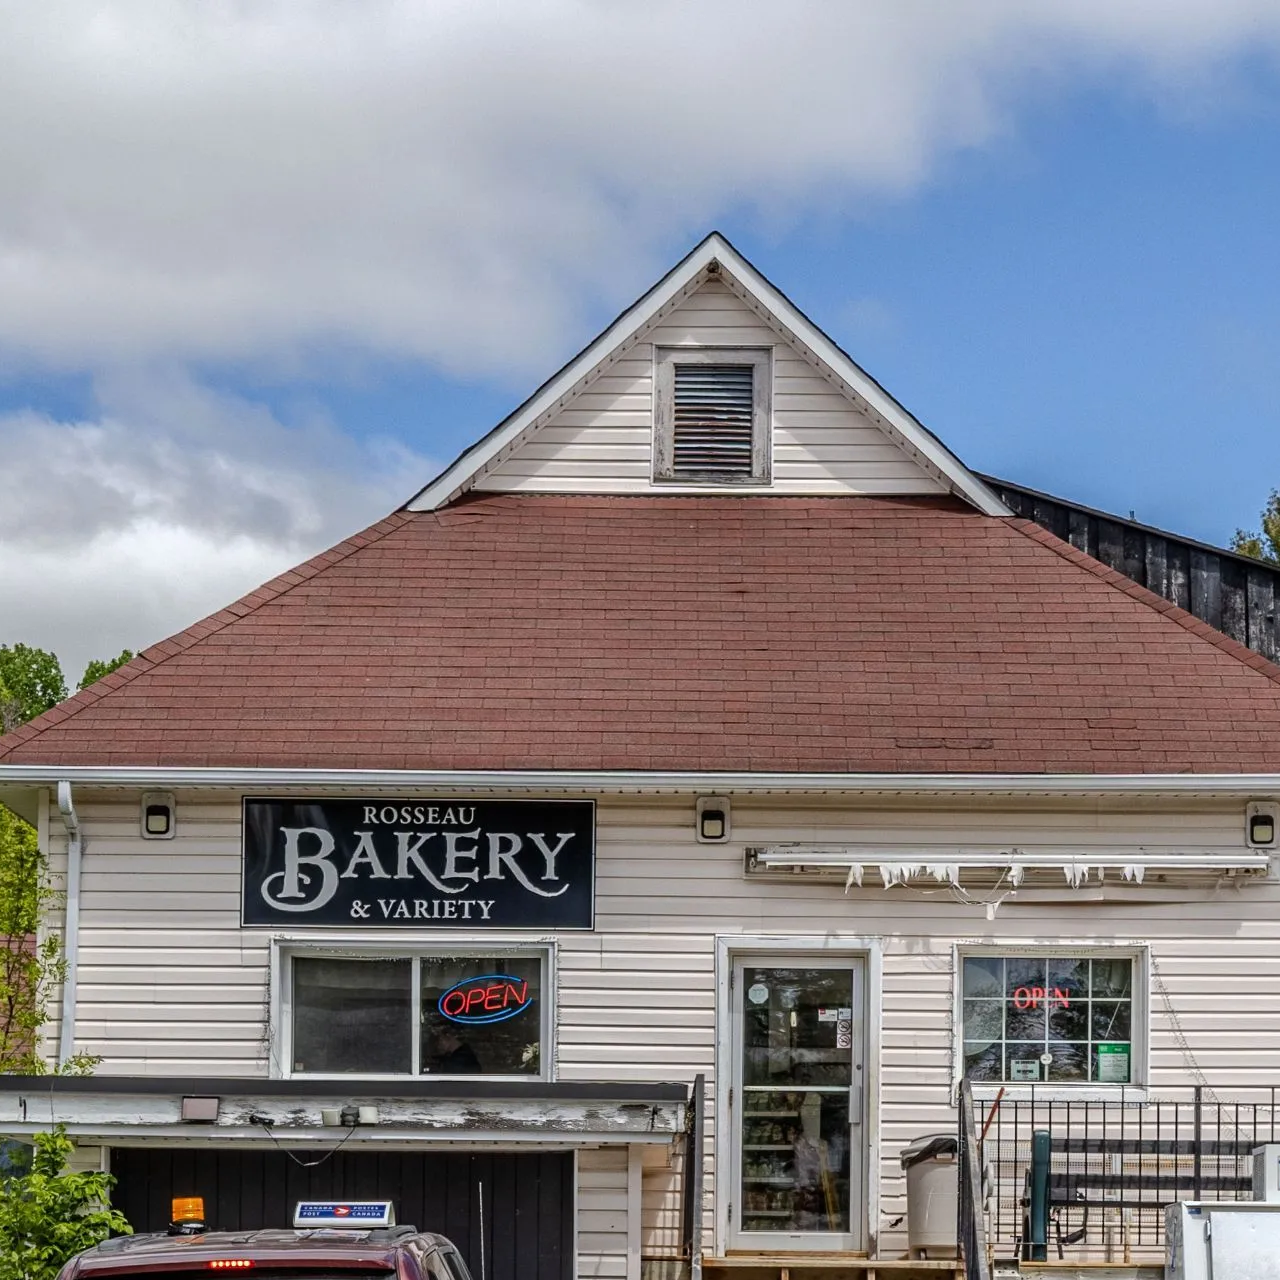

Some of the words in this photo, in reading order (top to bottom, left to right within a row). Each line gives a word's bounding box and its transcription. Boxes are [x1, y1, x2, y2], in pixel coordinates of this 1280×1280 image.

[362, 806, 477, 825] ROSSEAU
[261, 826, 577, 912] BAKERY
[350, 900, 371, 919] &
[377, 899, 496, 920] VARIETY
[443, 980, 529, 1016] OPEN
[1014, 987, 1070, 1009] OPEN
